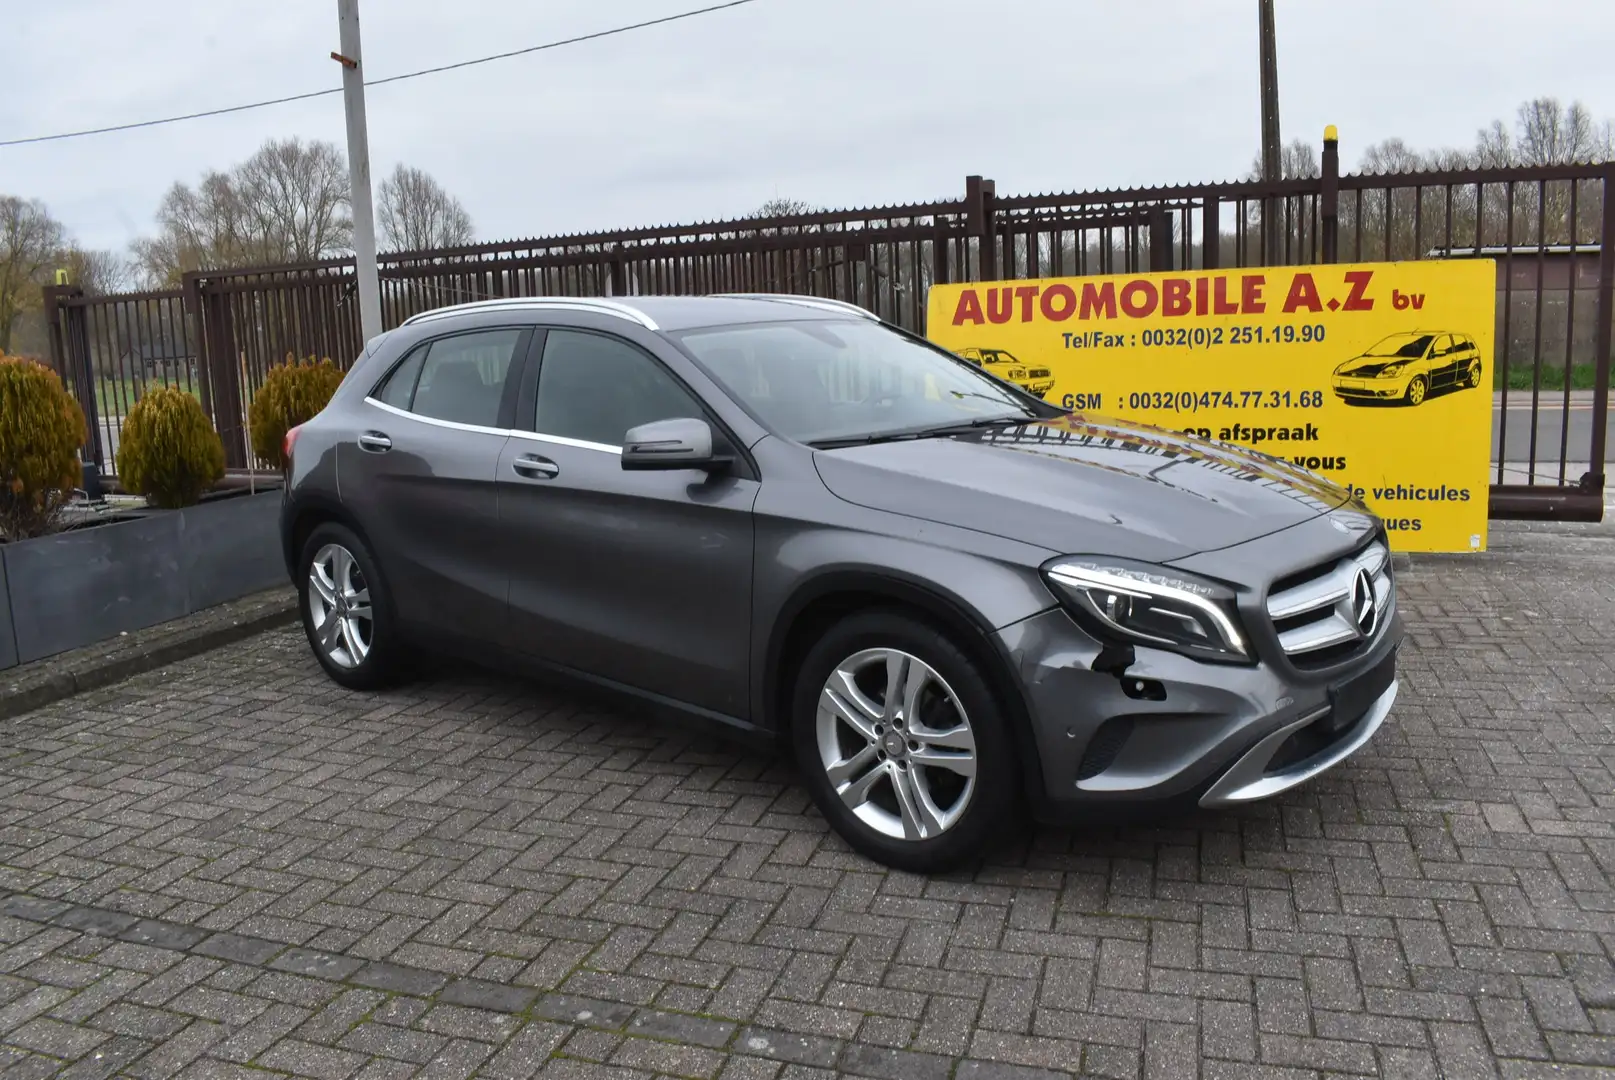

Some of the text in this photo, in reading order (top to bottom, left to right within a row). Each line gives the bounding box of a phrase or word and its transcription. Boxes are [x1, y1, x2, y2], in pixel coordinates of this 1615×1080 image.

[951, 270, 1426, 326] AUTOMOBILE A.Z bv
[1062, 331, 1125, 349] Tel/Fax
[1141, 327, 1224, 349] 0032(0)2
[1229, 324, 1326, 345] 251.19.90
[1061, 393, 1102, 410] GSM
[1128, 390, 1324, 413] 0032(0)474.77.31.68
[1218, 422, 1319, 445] afspraak
[1372, 484, 1471, 502] vehicules
[1381, 518, 1422, 532] ues
